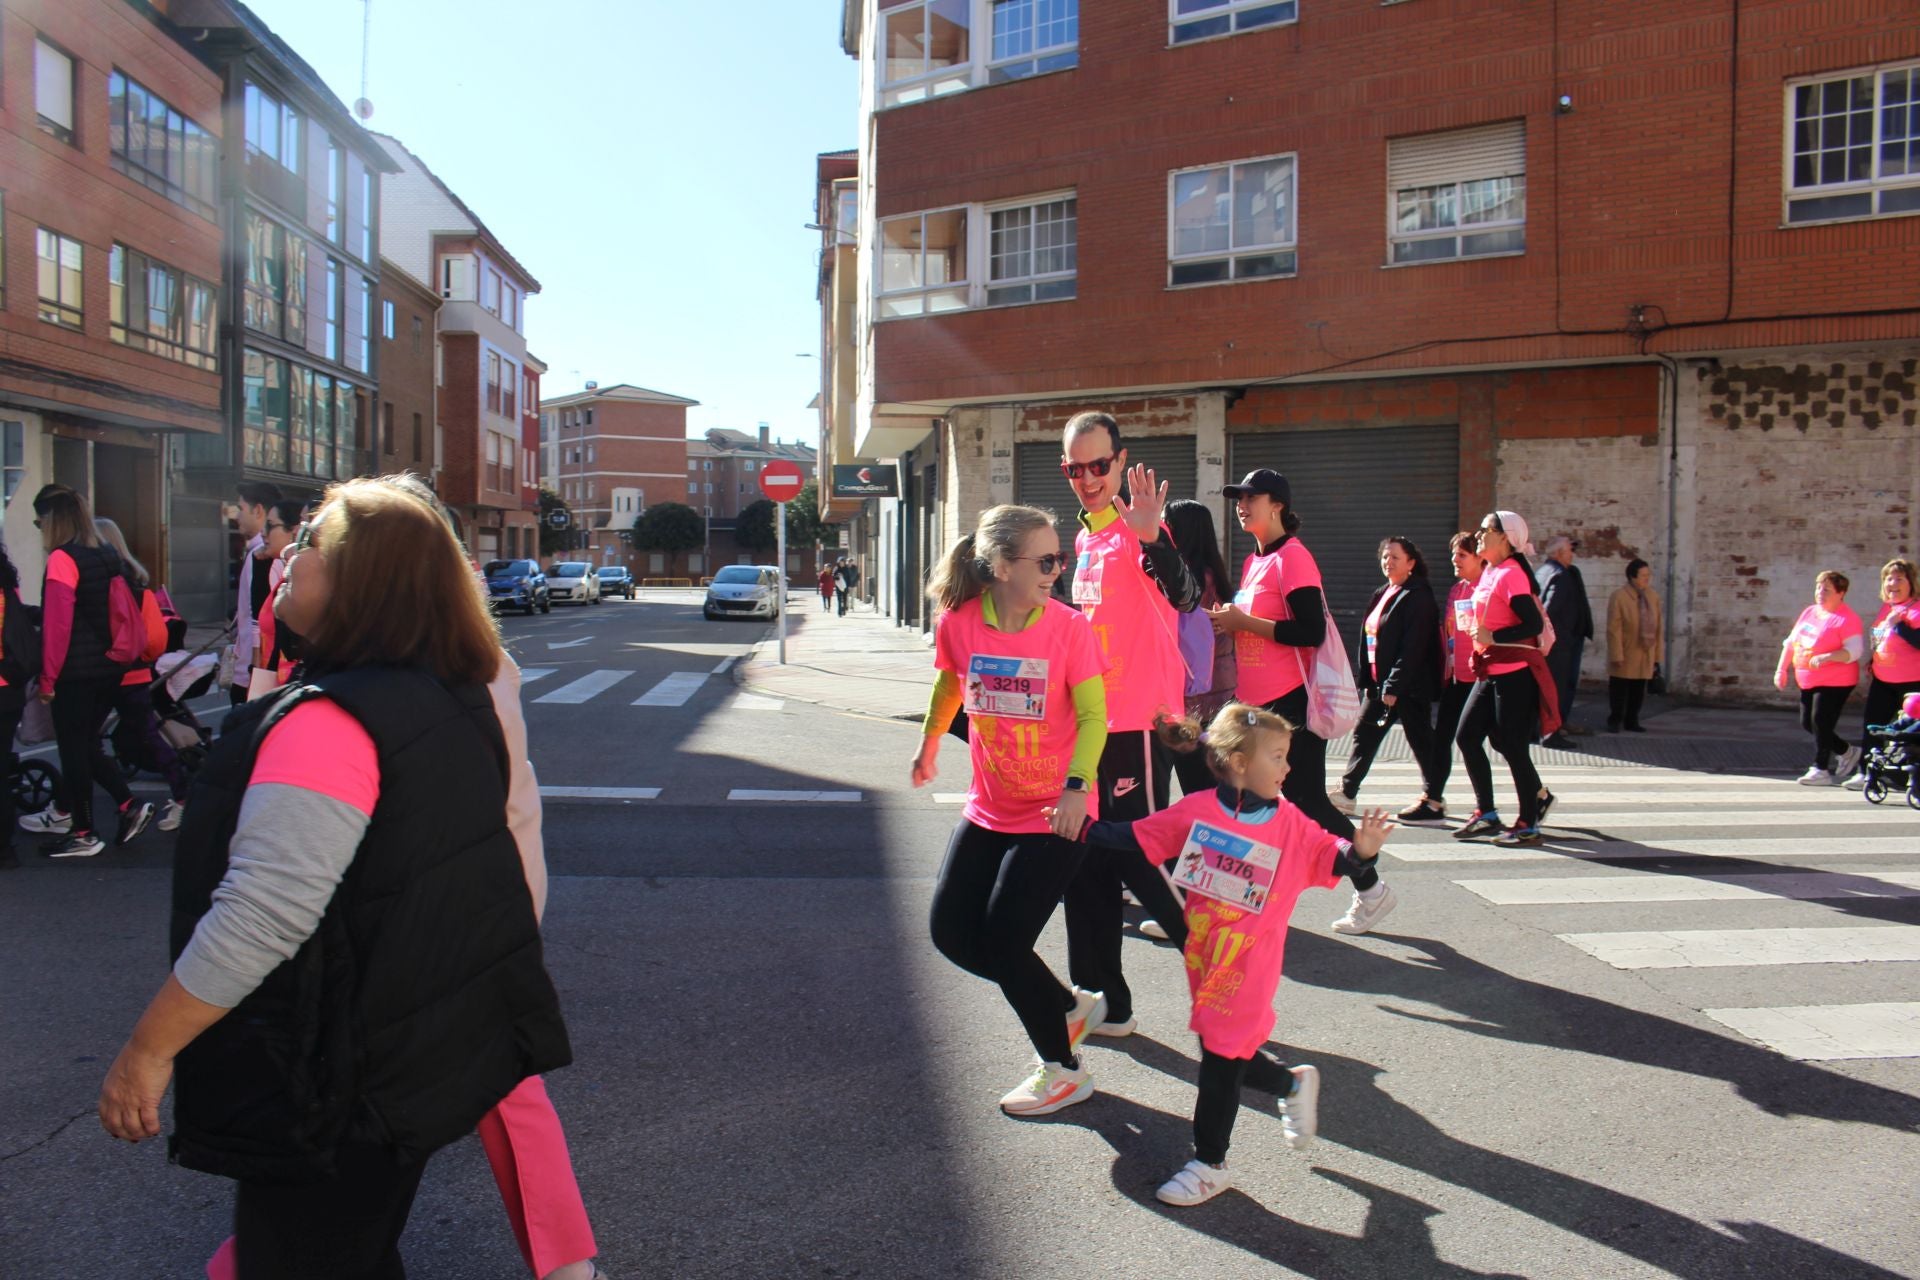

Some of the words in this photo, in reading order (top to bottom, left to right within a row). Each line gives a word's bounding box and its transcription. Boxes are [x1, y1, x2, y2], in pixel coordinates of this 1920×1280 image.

[993, 677, 1030, 692] 3219
[985, 695, 996, 710] 11
[1000, 756, 1058, 773] Carrera
[1117, 777, 1135, 788] NIKE
[1215, 854, 1254, 879] 1376
[1200, 871, 1214, 889] 11
